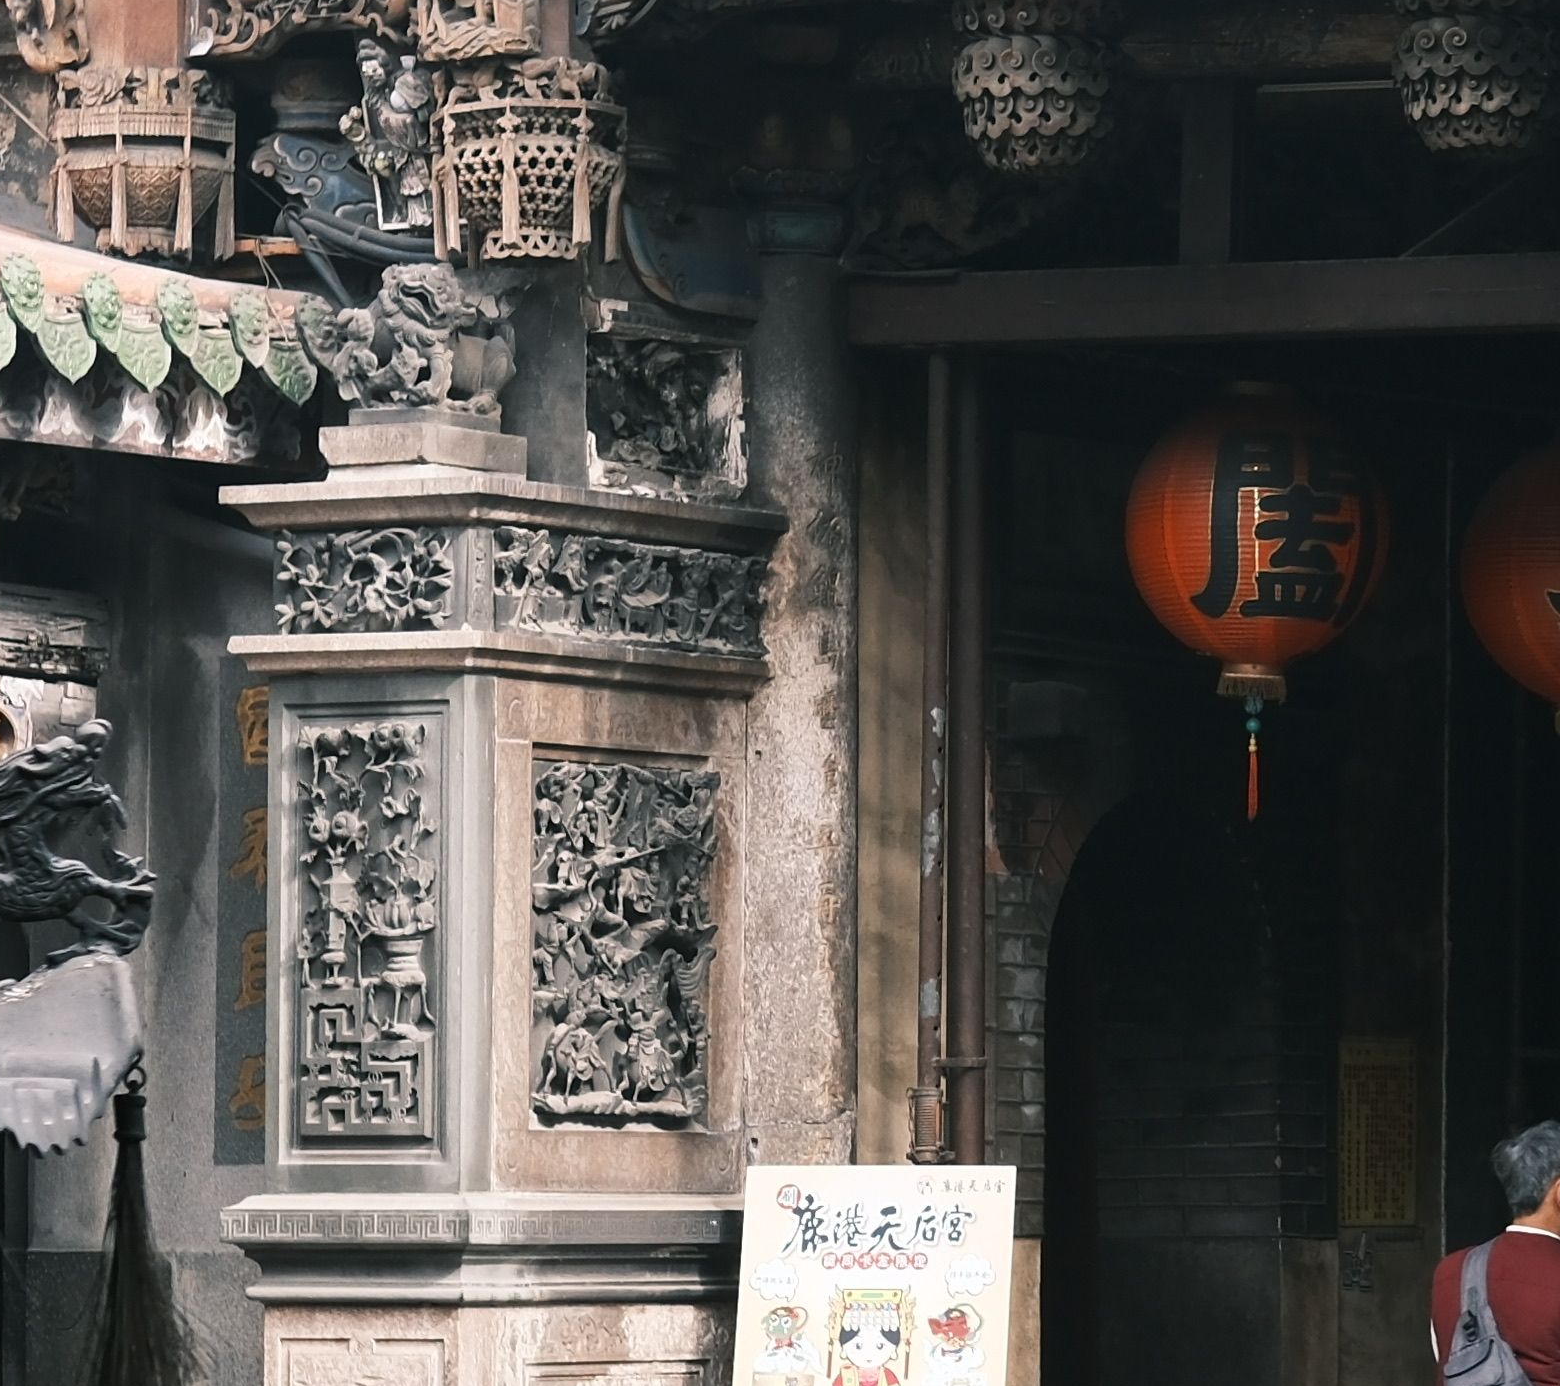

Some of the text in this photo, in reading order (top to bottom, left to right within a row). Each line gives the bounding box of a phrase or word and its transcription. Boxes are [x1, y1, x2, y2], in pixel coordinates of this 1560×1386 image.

[782, 1193, 973, 1254] 鹿港天后宮
